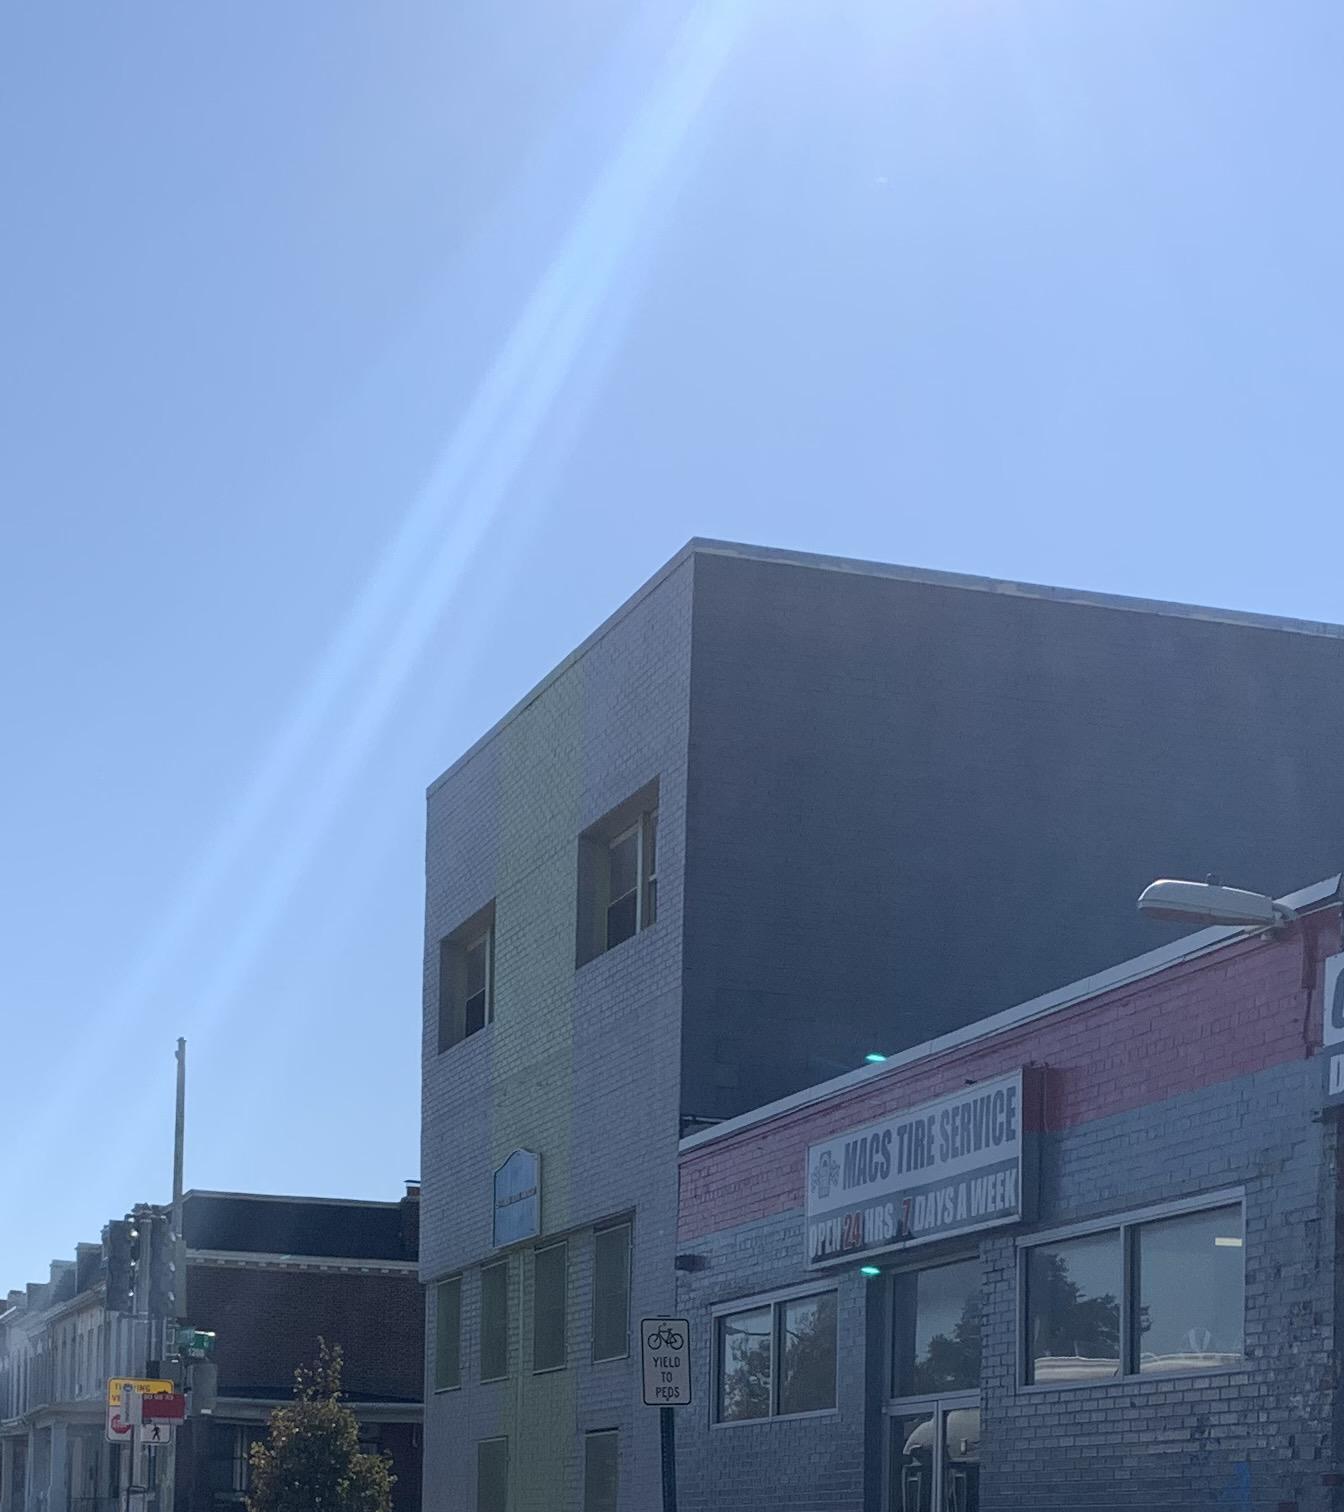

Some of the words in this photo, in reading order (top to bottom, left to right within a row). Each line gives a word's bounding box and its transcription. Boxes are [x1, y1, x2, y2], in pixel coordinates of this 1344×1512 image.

[842, 1129, 892, 1190] MACS
[897, 1114, 935, 1174] TIRE
[939, 1085, 1016, 1164] SERVICE
[808, 1216, 842, 1258] OPEN
[842, 1211, 864, 1250] 24
[901, 1197, 912, 1237] 7
[913, 1187, 954, 1232] DAYS
[955, 1183, 968, 1221] A
[969, 1168, 1017, 1217] WEEK
[652, 1356, 681, 1368] YIELD
[661, 1371, 673, 1383] TO
[655, 1386, 681, 1399] PEDS
